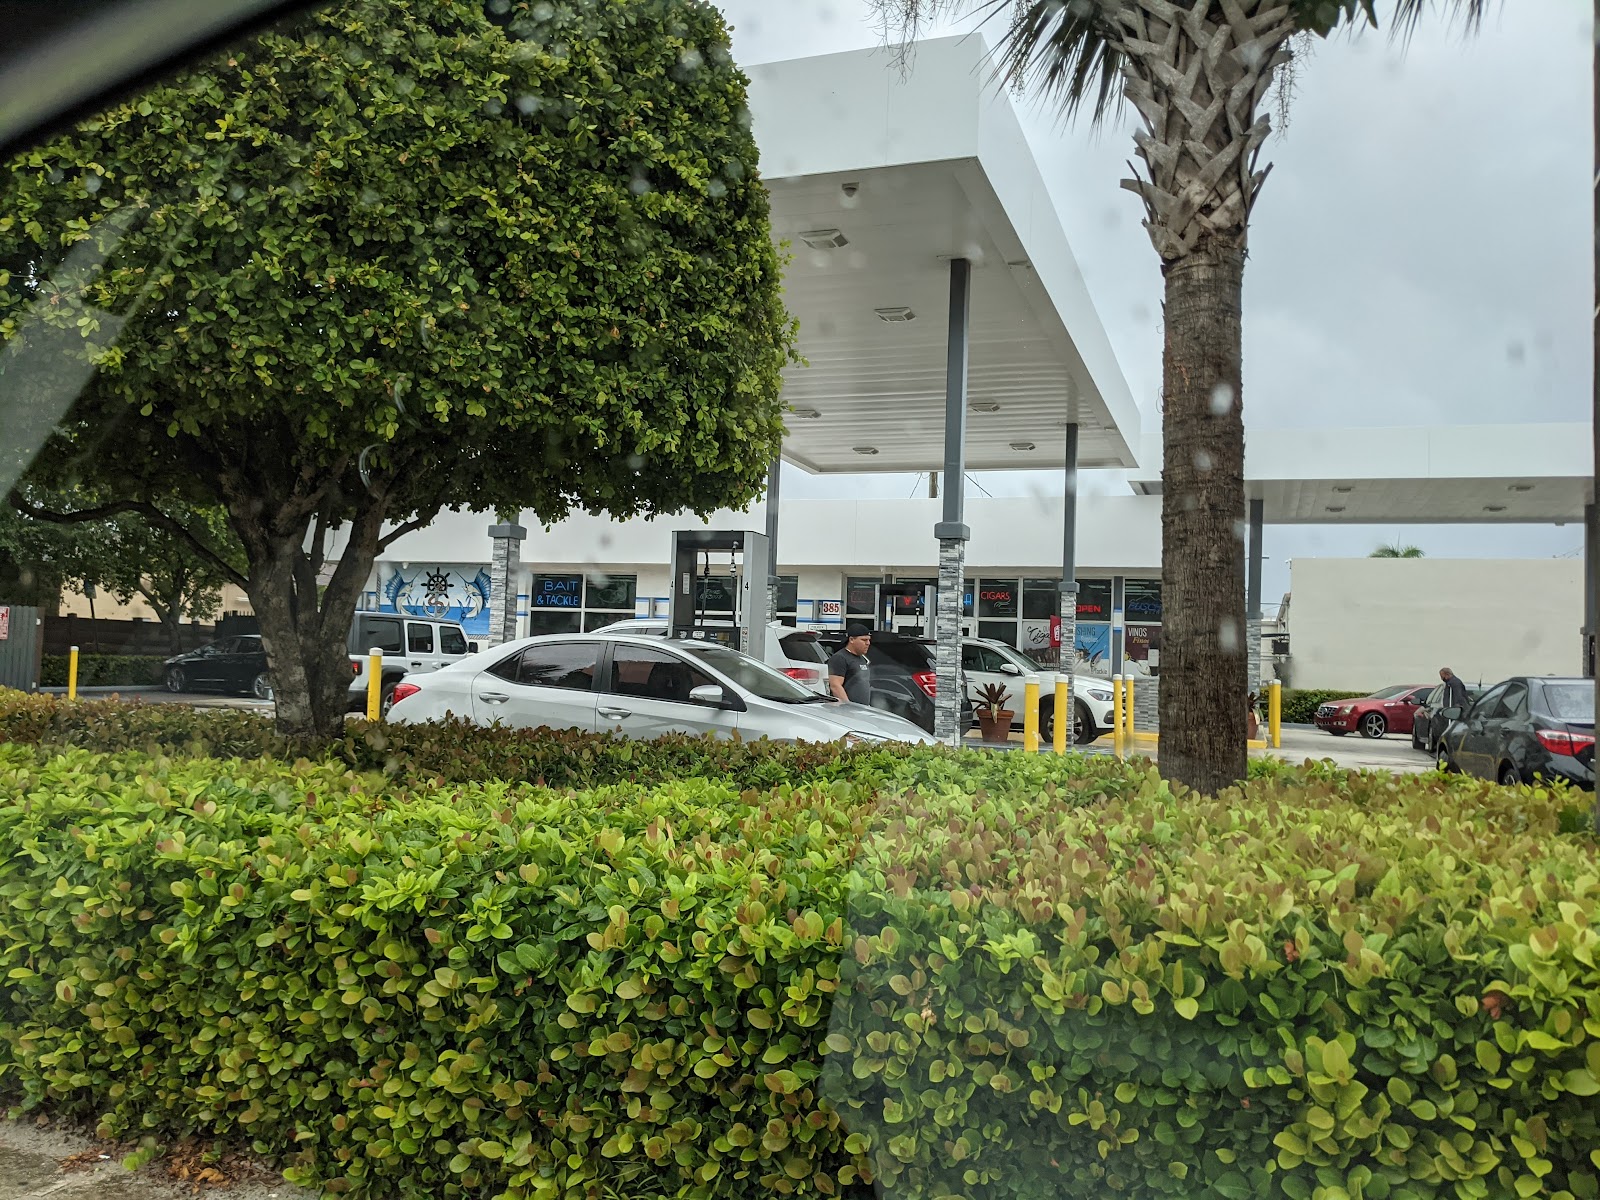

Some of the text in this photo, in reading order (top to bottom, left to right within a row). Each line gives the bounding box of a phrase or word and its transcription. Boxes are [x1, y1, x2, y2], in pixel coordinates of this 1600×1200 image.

[544, 581, 578, 591] BAIT
[744, 581, 749, 591] 4
[537, 595, 579, 606] & TACKLE
[980, 591, 1010, 601] CIGARS
[823, 603, 840, 613] 385
[1076, 605, 1102, 613] OPEN
[1027, 626, 1051, 645] Ciga
[1128, 628, 1148, 637] VINOS
